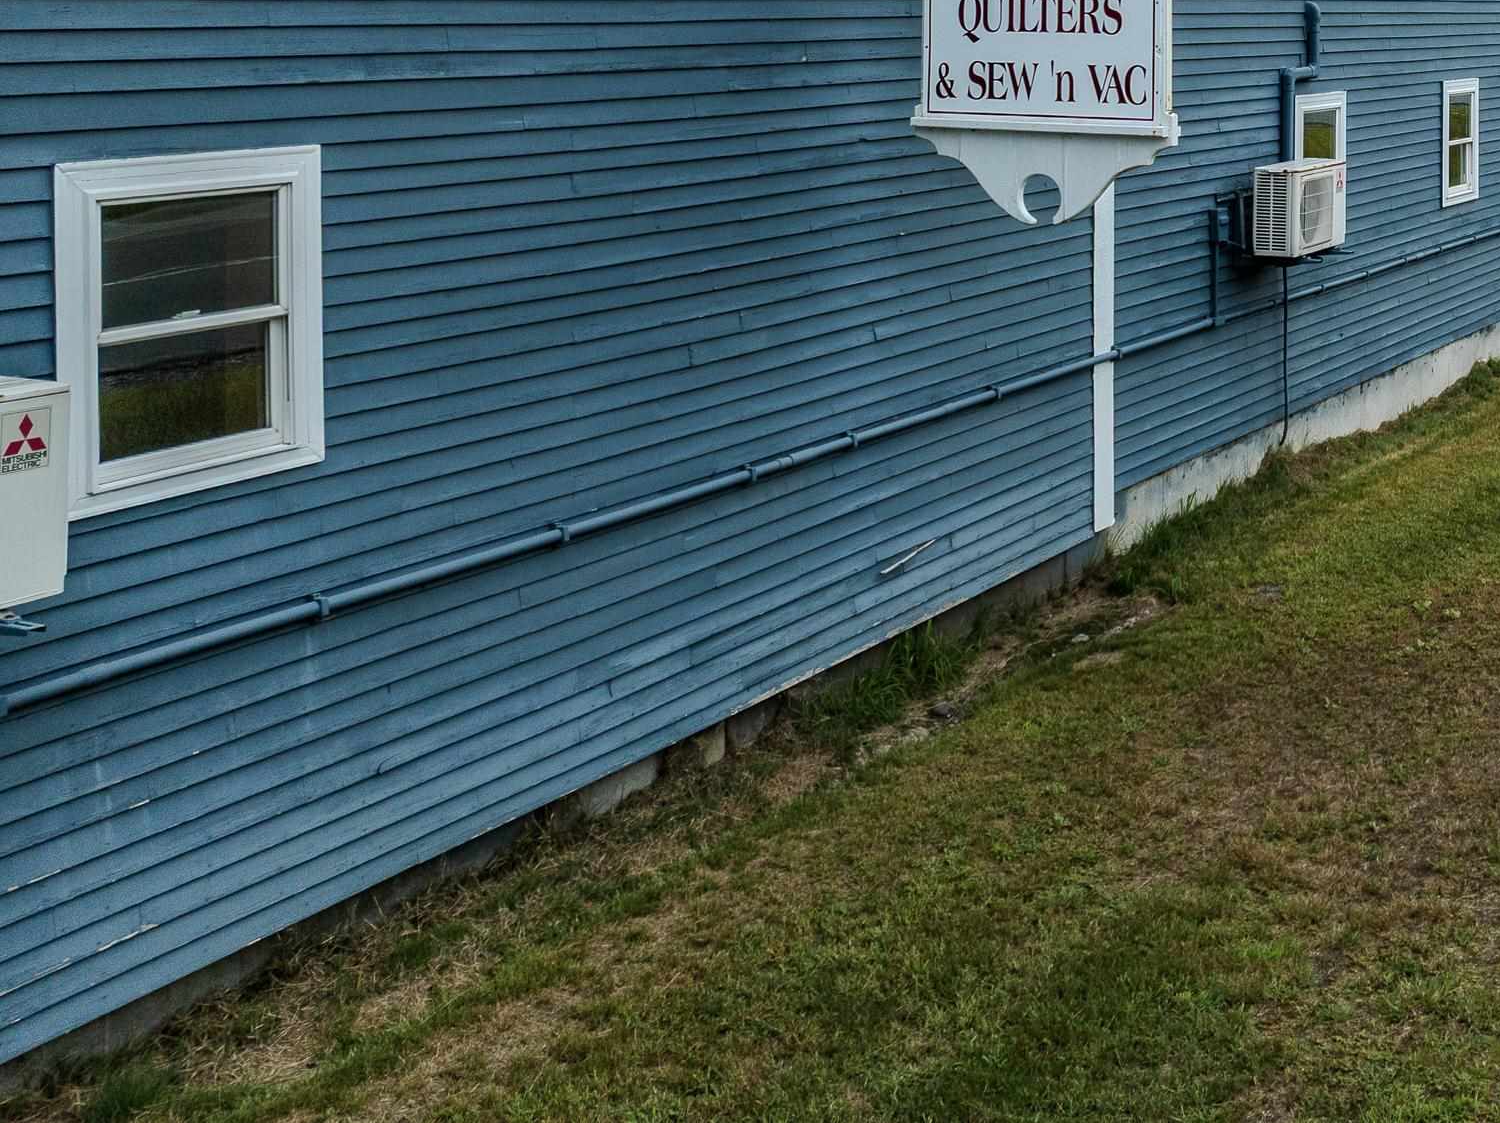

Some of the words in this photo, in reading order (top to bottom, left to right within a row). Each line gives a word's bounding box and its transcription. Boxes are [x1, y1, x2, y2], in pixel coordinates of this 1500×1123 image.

[936, 62, 957, 99] &
[967, 61, 1039, 100] SEW
[1088, 65, 1147, 106] VAC
[2, 450, 47, 464] MITSUBISHI
[2, 461, 41, 473] ELECTRIC
